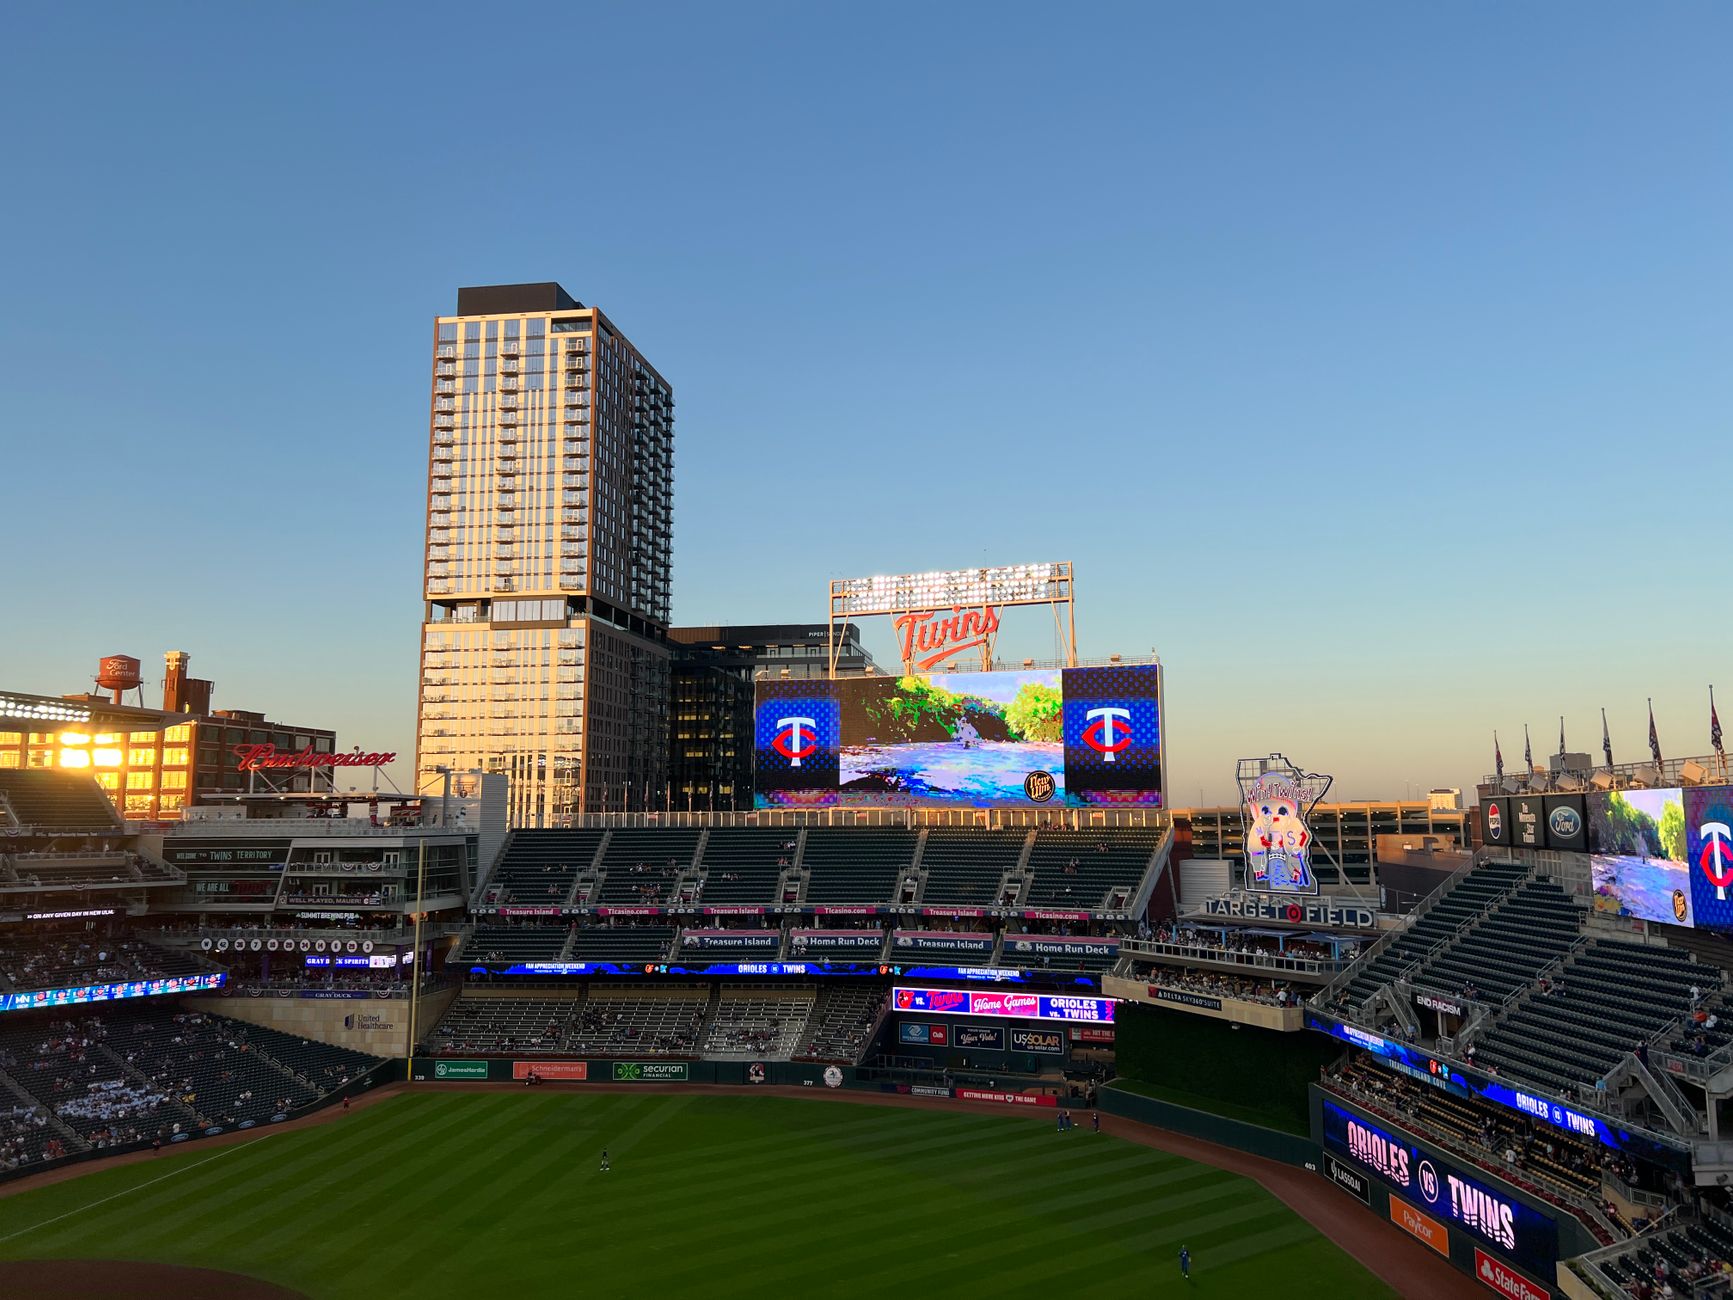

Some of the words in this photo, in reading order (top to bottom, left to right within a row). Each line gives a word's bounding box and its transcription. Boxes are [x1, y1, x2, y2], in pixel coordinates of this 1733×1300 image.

[895, 605, 1000, 667] Twins
[106, 659, 128, 670] Ford
[233, 743, 397, 771] Budweiser
[1031, 774, 1051, 788] New
[1247, 782, 1272, 803] Win!
[1273, 779, 1312, 803] Twins!
[1555, 811, 1574, 833] Ford
[210, 852, 232, 860] TWINS
[236, 850, 273, 859] TERRITORY
[207, 884, 218, 892] ARE
[219, 884, 230, 892] ALL
[1205, 899, 1284, 920] TARGET
[1306, 905, 1377, 929] FIELD
[704, 937, 743, 946] Treasure
[744, 937, 771, 945] Island
[810, 937, 836, 945] Home
[838, 937, 855, 945] Run
[858, 937, 879, 945] Deck
[918, 940, 956, 948] Treasure
[957, 940, 984, 949] Island
[1036, 944, 1063, 952] Home
[1065, 944, 1083, 953] Run
[1086, 945, 1109, 954] Deck
[738, 964, 767, 973] ORIOLES
[783, 965, 806, 974] TWINS
[926, 991, 964, 1010] Twins
[974, 998, 1001, 1012] Home
[1003, 995, 1036, 1011] Games
[1050, 998, 1097, 1009] ORIOLES
[1163, 991, 1181, 1000] DELTA
[1204, 998, 1220, 1008] SUITE
[1416, 995, 1432, 1007] END
[1432, 1000, 1460, 1016] RACISM
[358, 1014, 380, 1022] United
[1063, 1008, 1099, 1020] TWINS
[358, 1022, 394, 1030] Healthcare
[960, 1033, 978, 1045] Your
[979, 1032, 997, 1042] Vote!
[643, 1064, 683, 1073] securian
[911, 1087, 937, 1095] COMMUNITY
[1516, 1092, 1548, 1118] ORIOLES
[1566, 1111, 1595, 1137] TWINS
[1338, 1169, 1360, 1192] LASSO.AI
[1348, 1120, 1409, 1187] ORIOLES
[1422, 1169, 1435, 1195] VS
[1448, 1174, 1515, 1249] TWINS
[1403, 1210, 1432, 1238] Paycor
